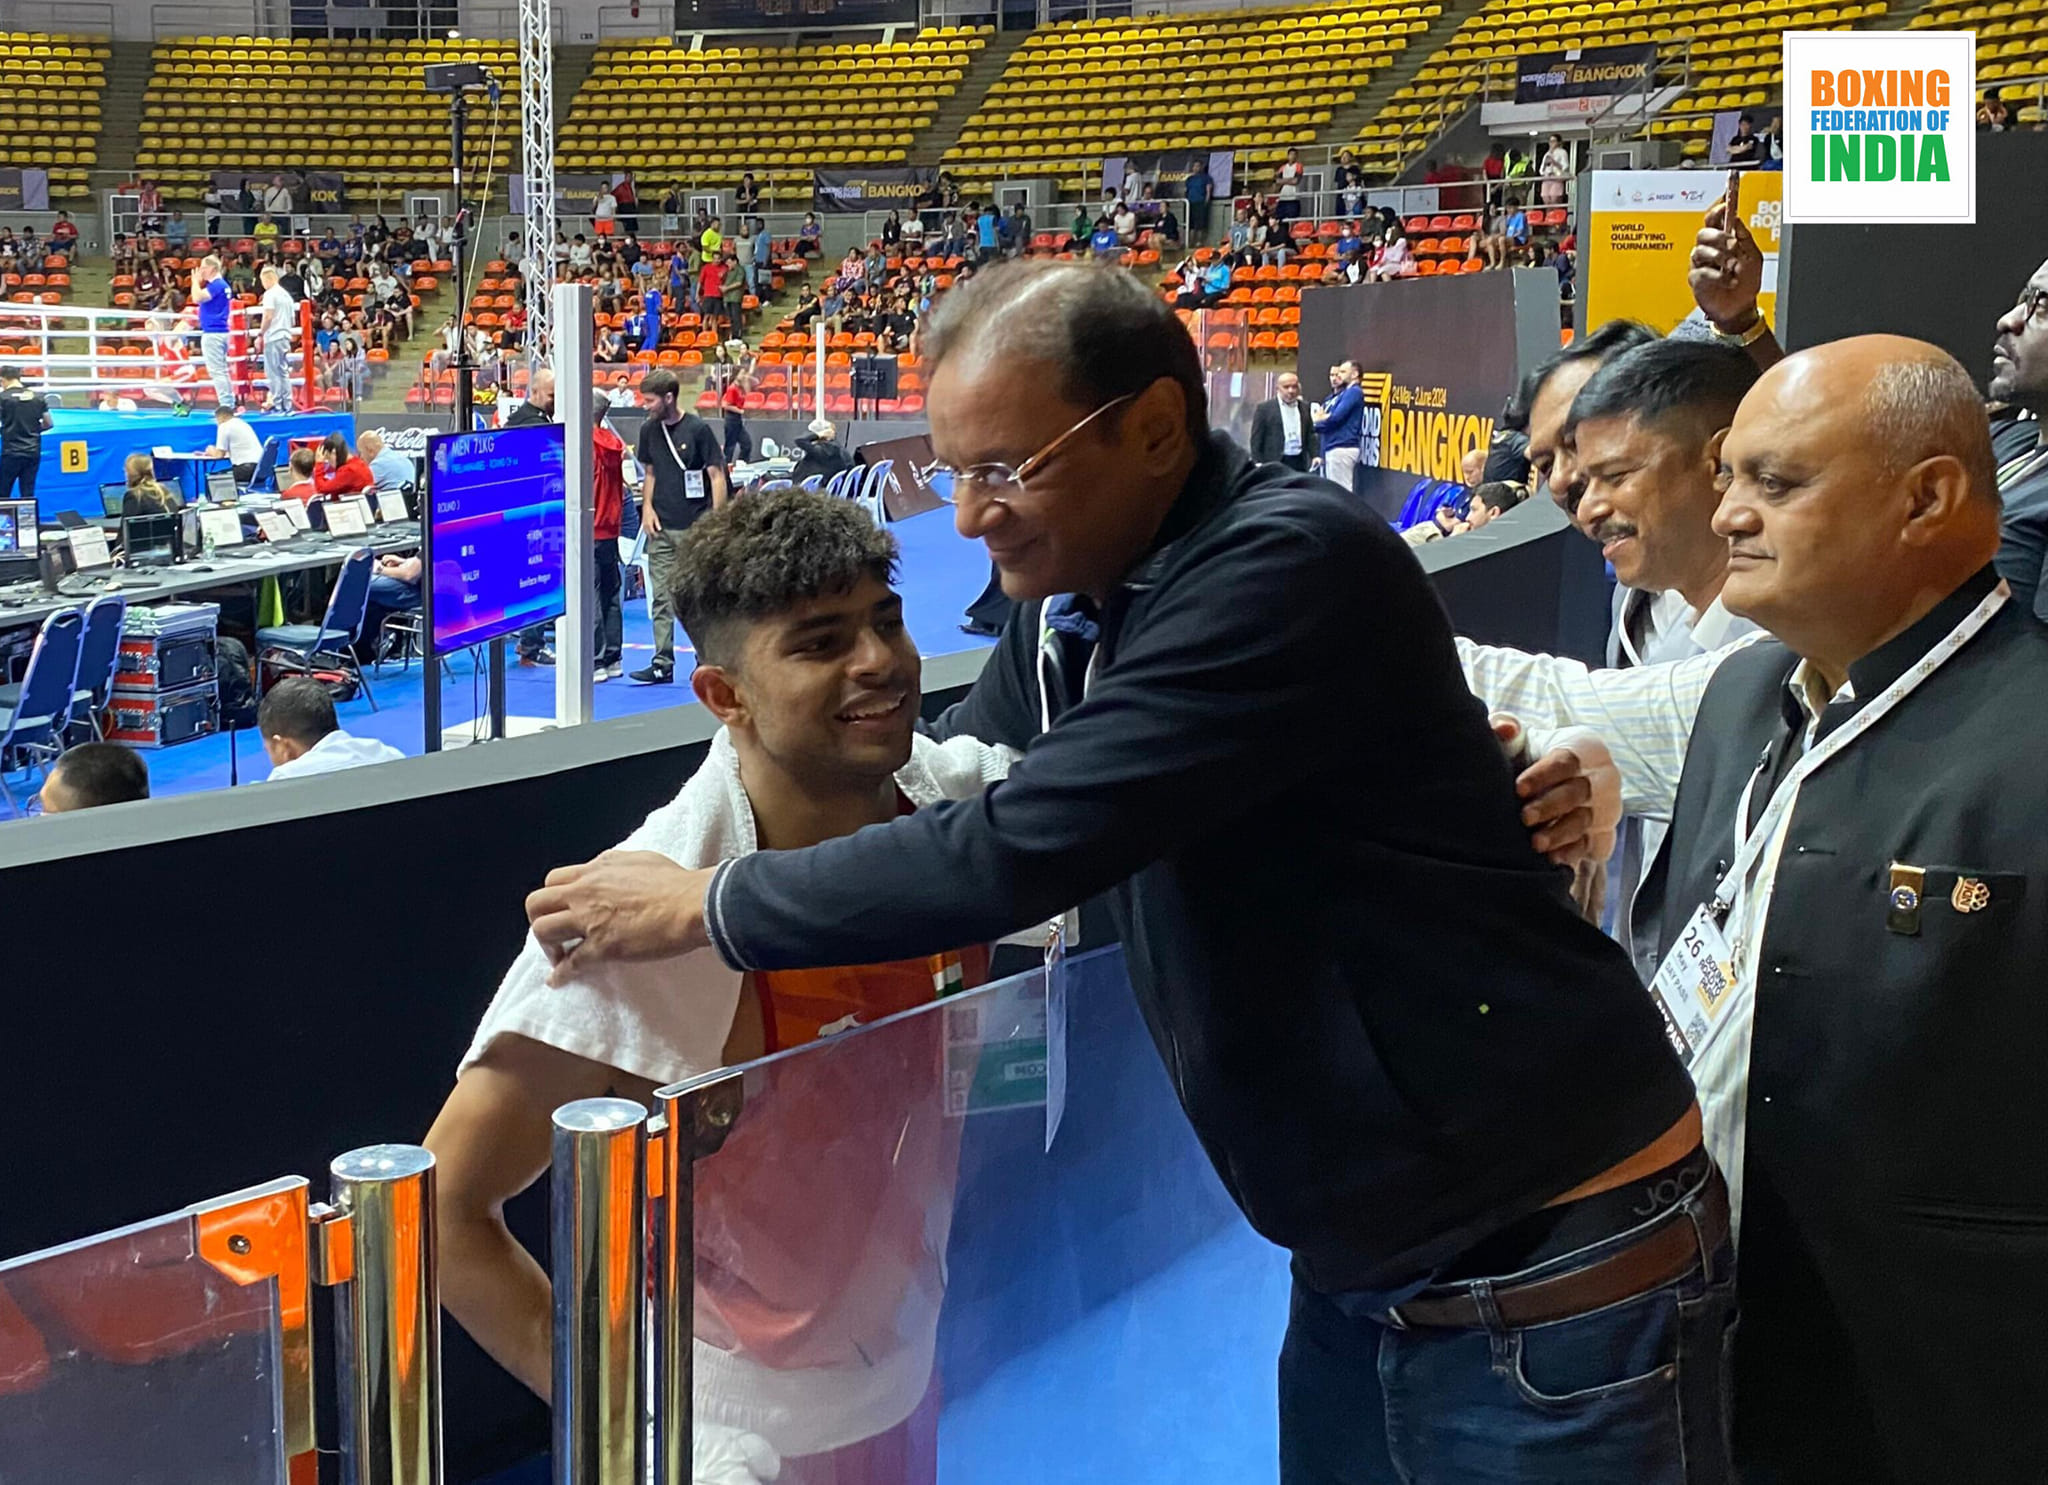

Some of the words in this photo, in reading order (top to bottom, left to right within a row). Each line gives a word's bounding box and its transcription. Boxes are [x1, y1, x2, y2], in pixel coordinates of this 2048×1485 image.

[1573, 63, 1648, 83] BANGKOK
[868, 184, 923, 198] BANGKO
[1611, 223, 1645, 232] WORLD
[1611, 233, 1667, 242] QUALIFYING
[1611, 242, 1675, 251] TOURNAMENT
[1392, 385, 1400, 404] 24
[1432, 386, 1447, 408] 2024
[451, 440, 470, 456] MEN
[474, 436, 495, 454] 71KG
[780, 444, 806, 459] bc
[70, 448, 80, 466] B
[1683, 926, 1705, 958] 26
[1665, 961, 1677, 981] DAY
[1674, 979, 1689, 1002] PASS
[1699, 959, 1715, 986] ROAD
[1706, 954, 1727, 989] BOXING
[1666, 1023, 1686, 1056] PASS
